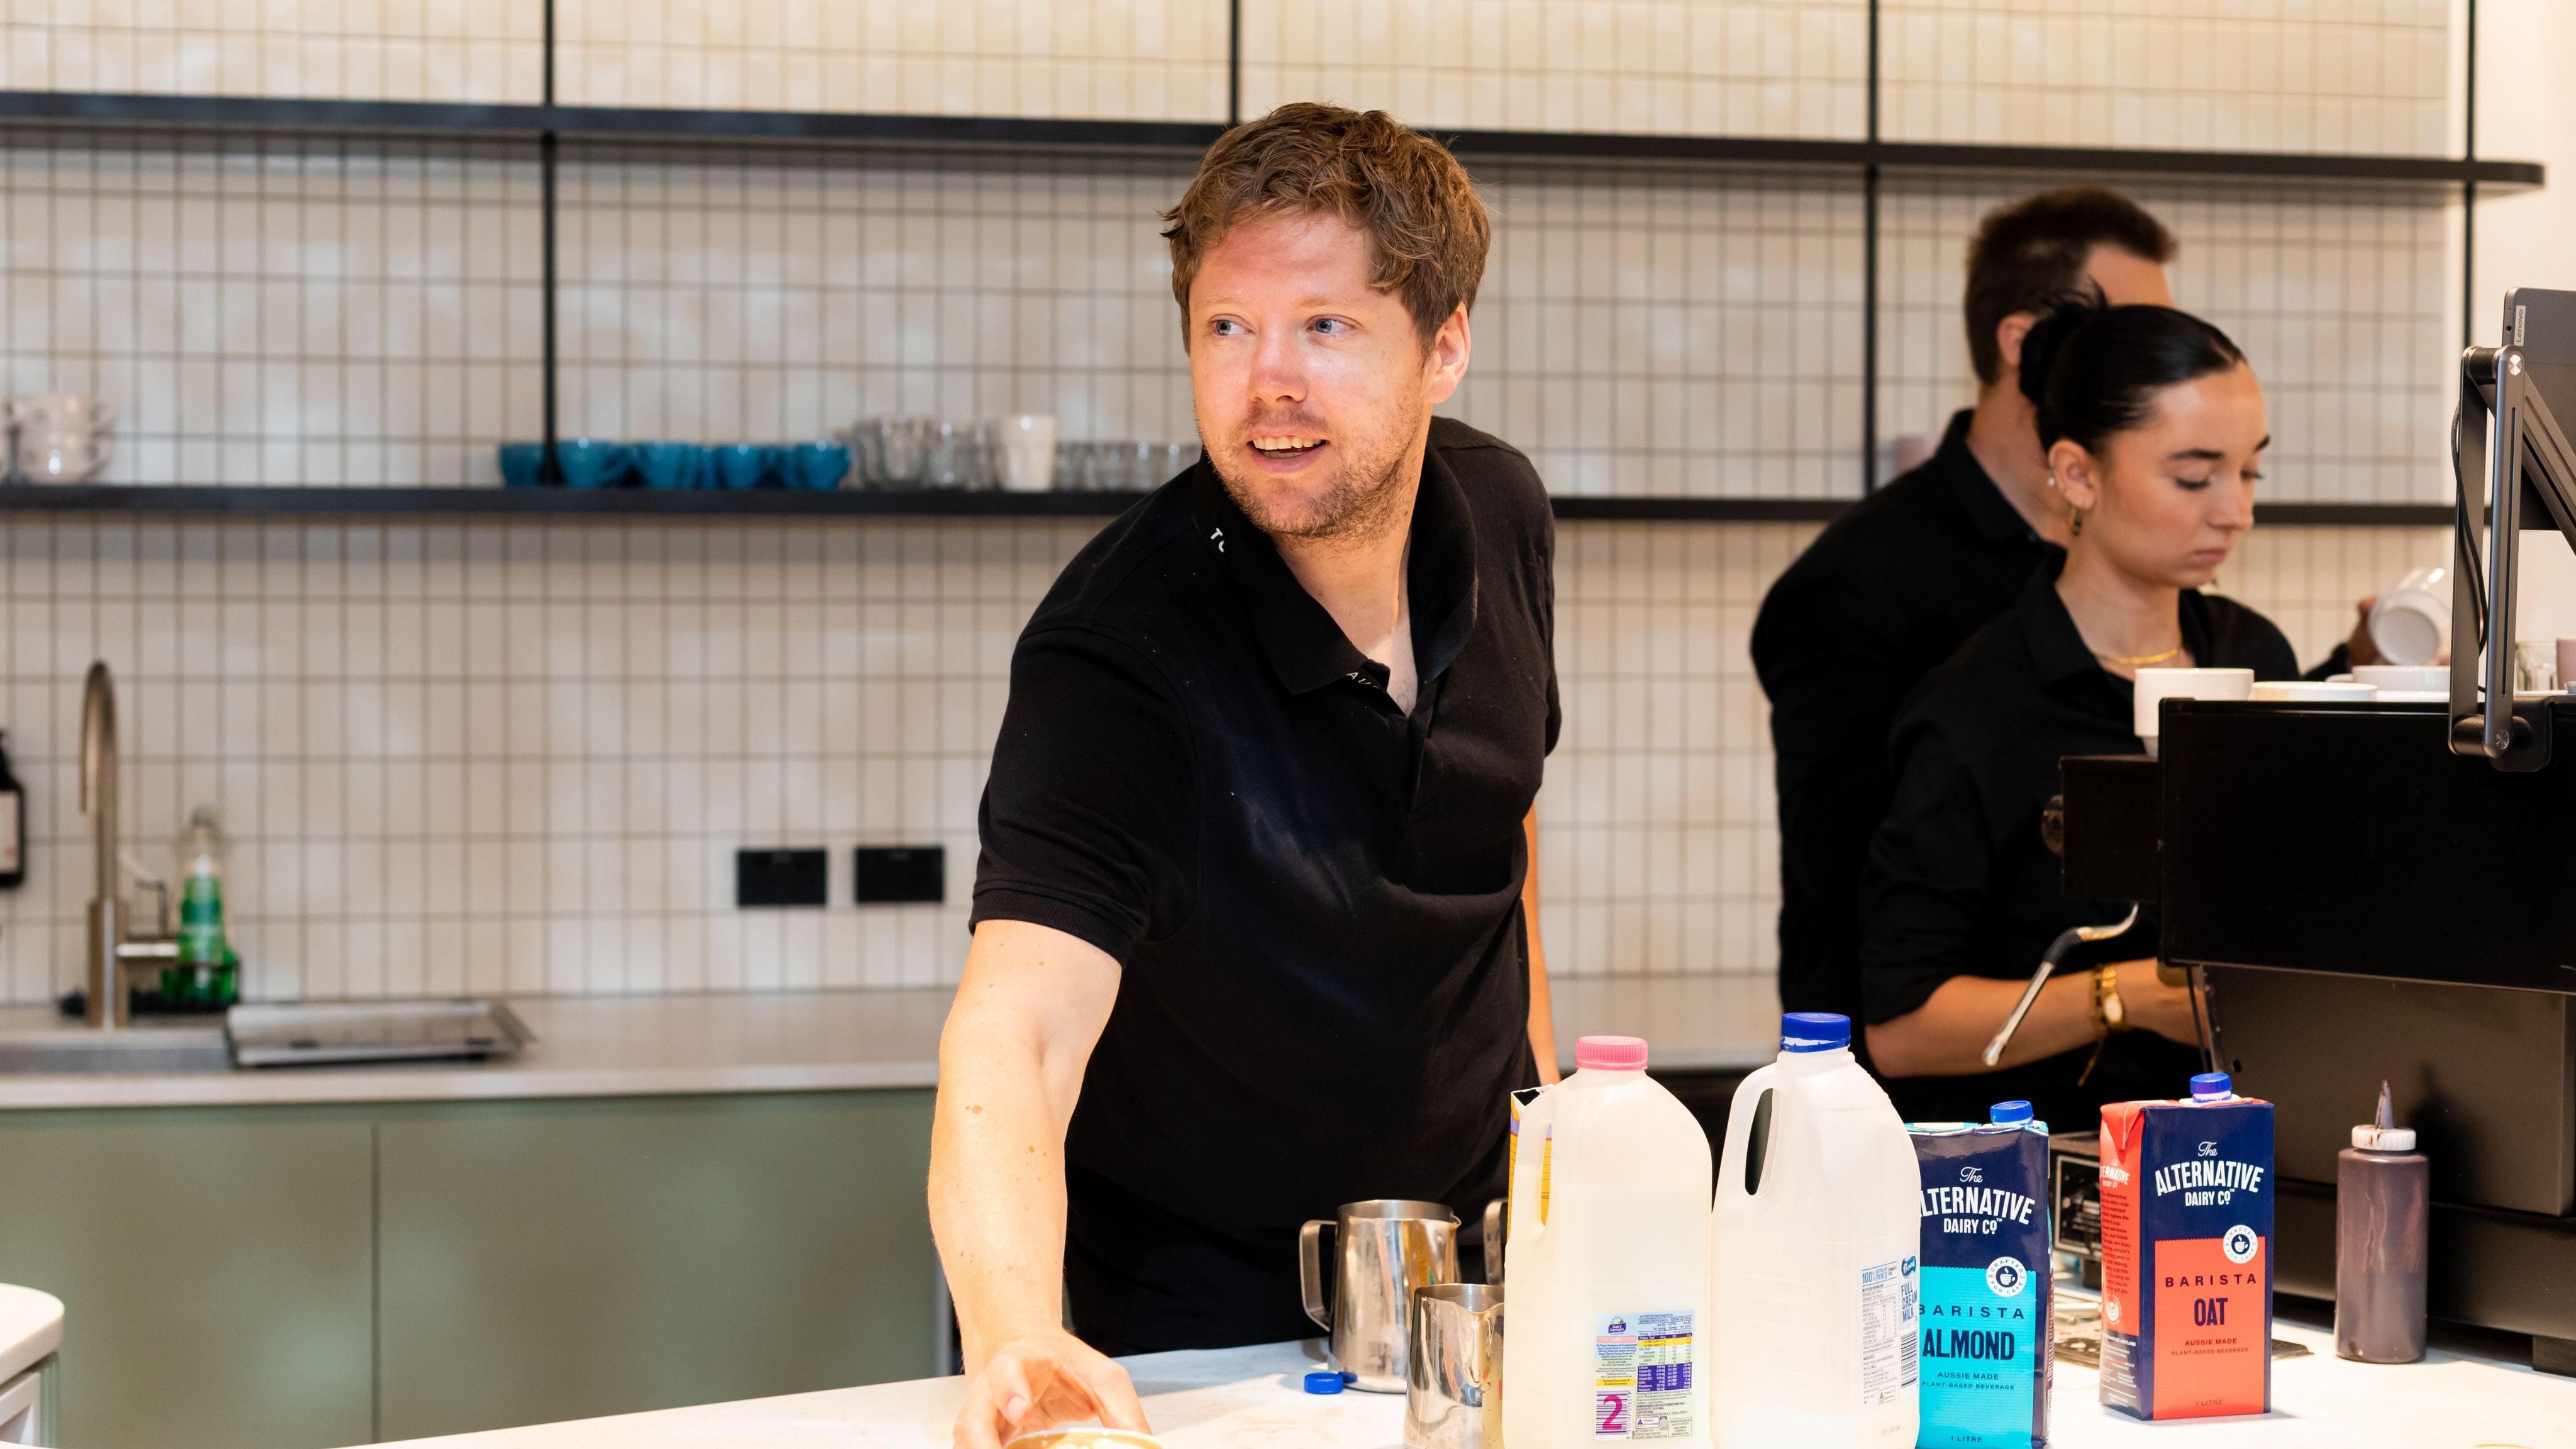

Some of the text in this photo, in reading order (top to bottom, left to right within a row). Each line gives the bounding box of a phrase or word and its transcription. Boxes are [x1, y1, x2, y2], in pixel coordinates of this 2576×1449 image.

[2198, 1141, 2218, 1157] The
[1960, 1166, 1983, 1183] The
[2155, 1160, 2264, 1197] ALTERNATIVE
[2185, 1191, 2215, 1207] DAIRY
[1944, 1218, 1979, 1233] DAIRY
[1991, 1259, 2023, 1273] CRAFTED
[1901, 1280, 1913, 1297] FULL
[1991, 1281, 2002, 1293] FOR
[2165, 1274, 2256, 1287] BARISTA
[1902, 1290, 1917, 1310] CREAM
[1902, 1307, 1914, 1323] MILK
[1919, 1304, 2024, 1319] BARISTA
[2194, 1298, 2228, 1326] OAT
[1922, 1328, 2015, 1360] ALMOND
[1602, 1395, 1622, 1430] 2
